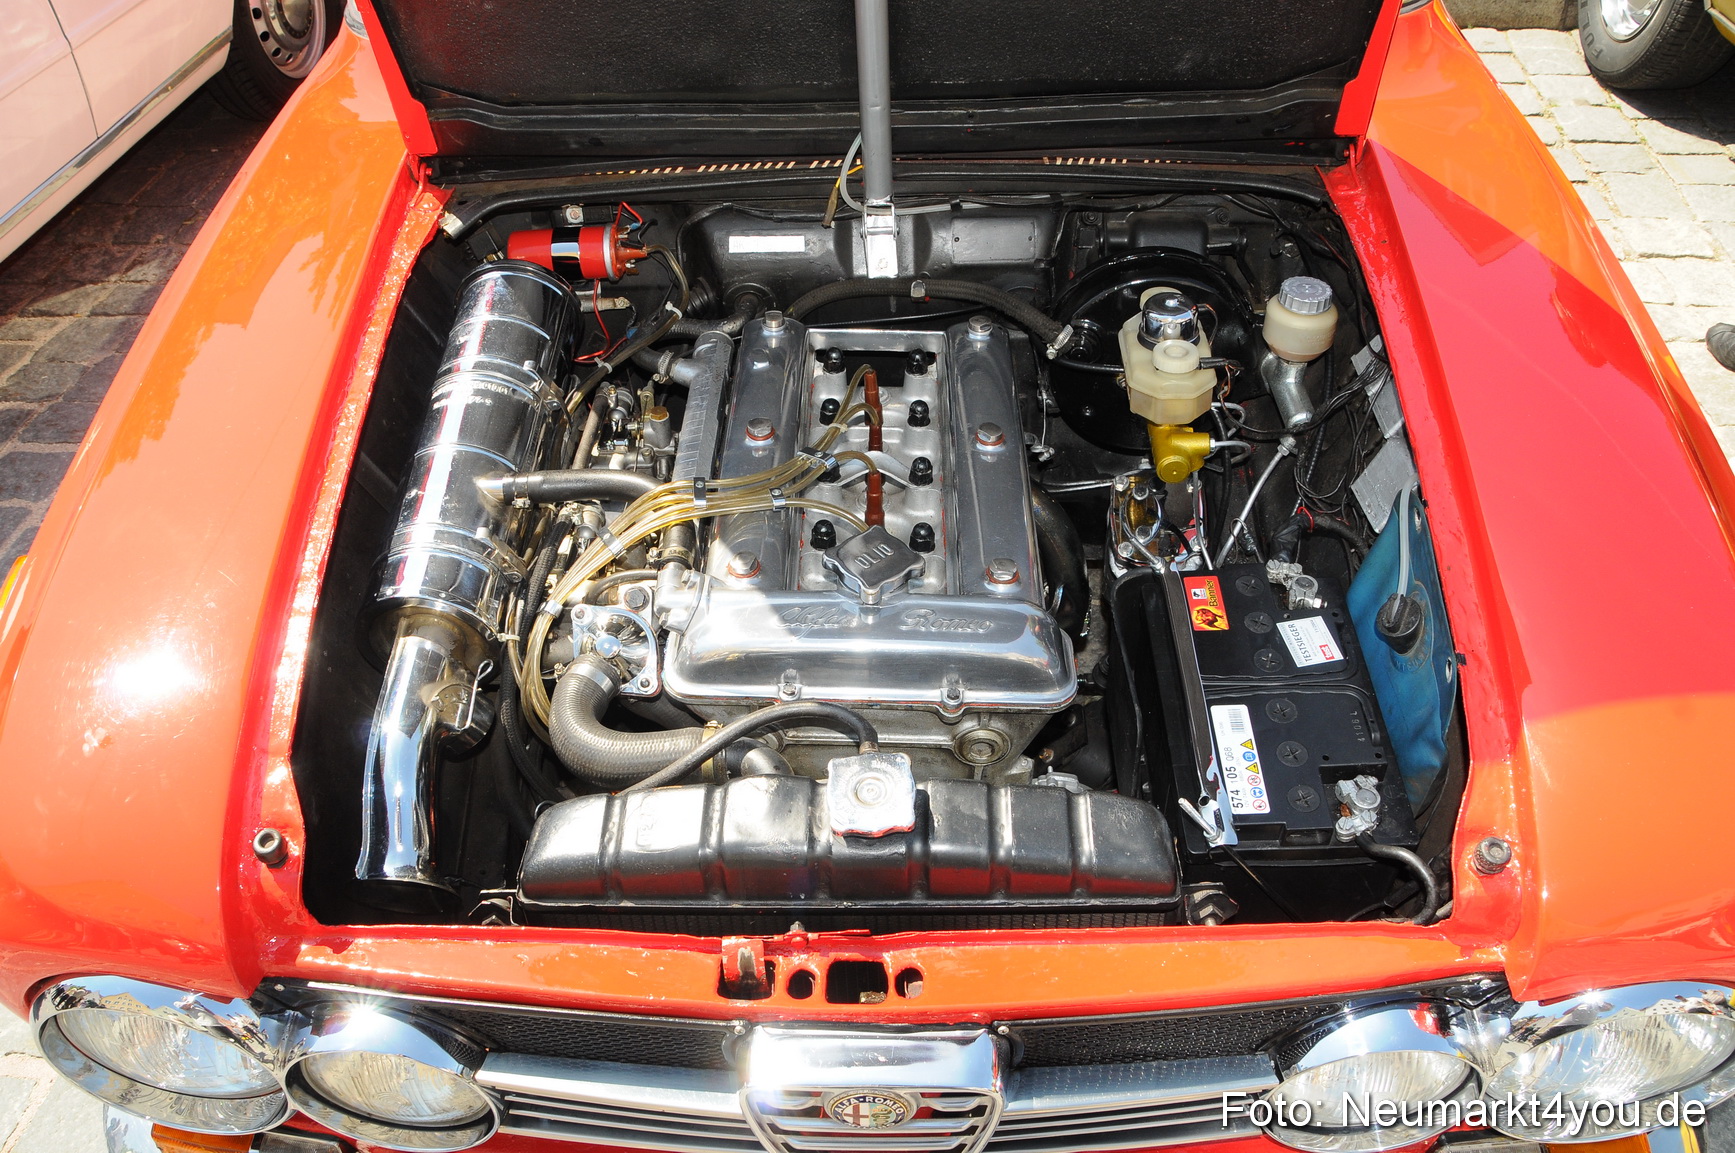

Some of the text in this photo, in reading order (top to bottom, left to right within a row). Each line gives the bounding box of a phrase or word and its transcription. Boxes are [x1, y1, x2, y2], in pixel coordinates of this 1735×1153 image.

[854, 543, 895, 569] OLIO
[1206, 580, 1219, 607] Banner
[776, 605, 993, 640] Alfa Romeo
[1287, 623, 1313, 662] TESTSIEGER
[1225, 766, 1239, 783] 105
[1229, 789, 1244, 808] 574
[834, 1096, 904, 1114] ALFA-ROMEO
